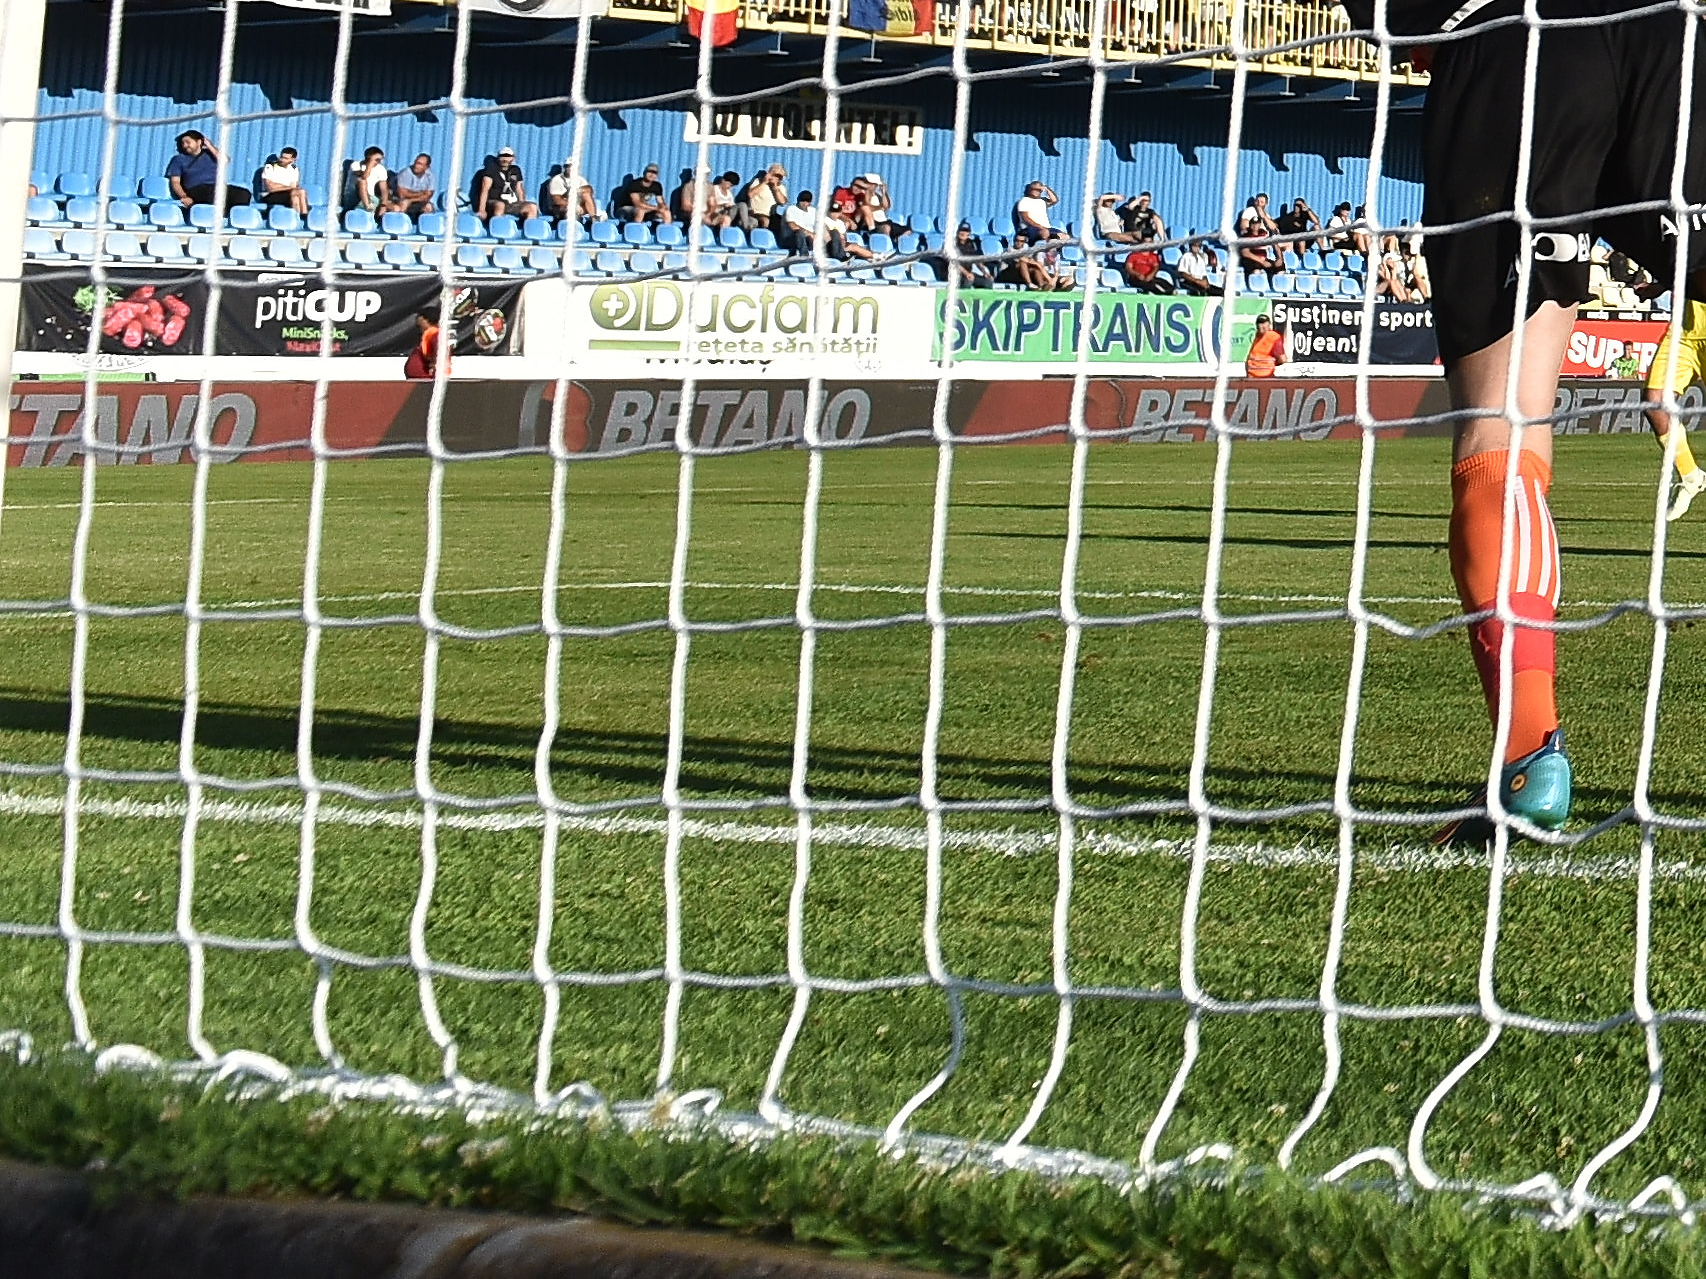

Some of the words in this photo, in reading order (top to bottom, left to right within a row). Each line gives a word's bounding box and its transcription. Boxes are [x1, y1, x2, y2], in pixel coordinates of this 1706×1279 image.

[254, 288, 382, 329] pitiCUP
[939, 299, 1191, 355] SKIPTRANS
[1379, 310, 1434, 331] sport
[8, 392, 257, 468] TANO
